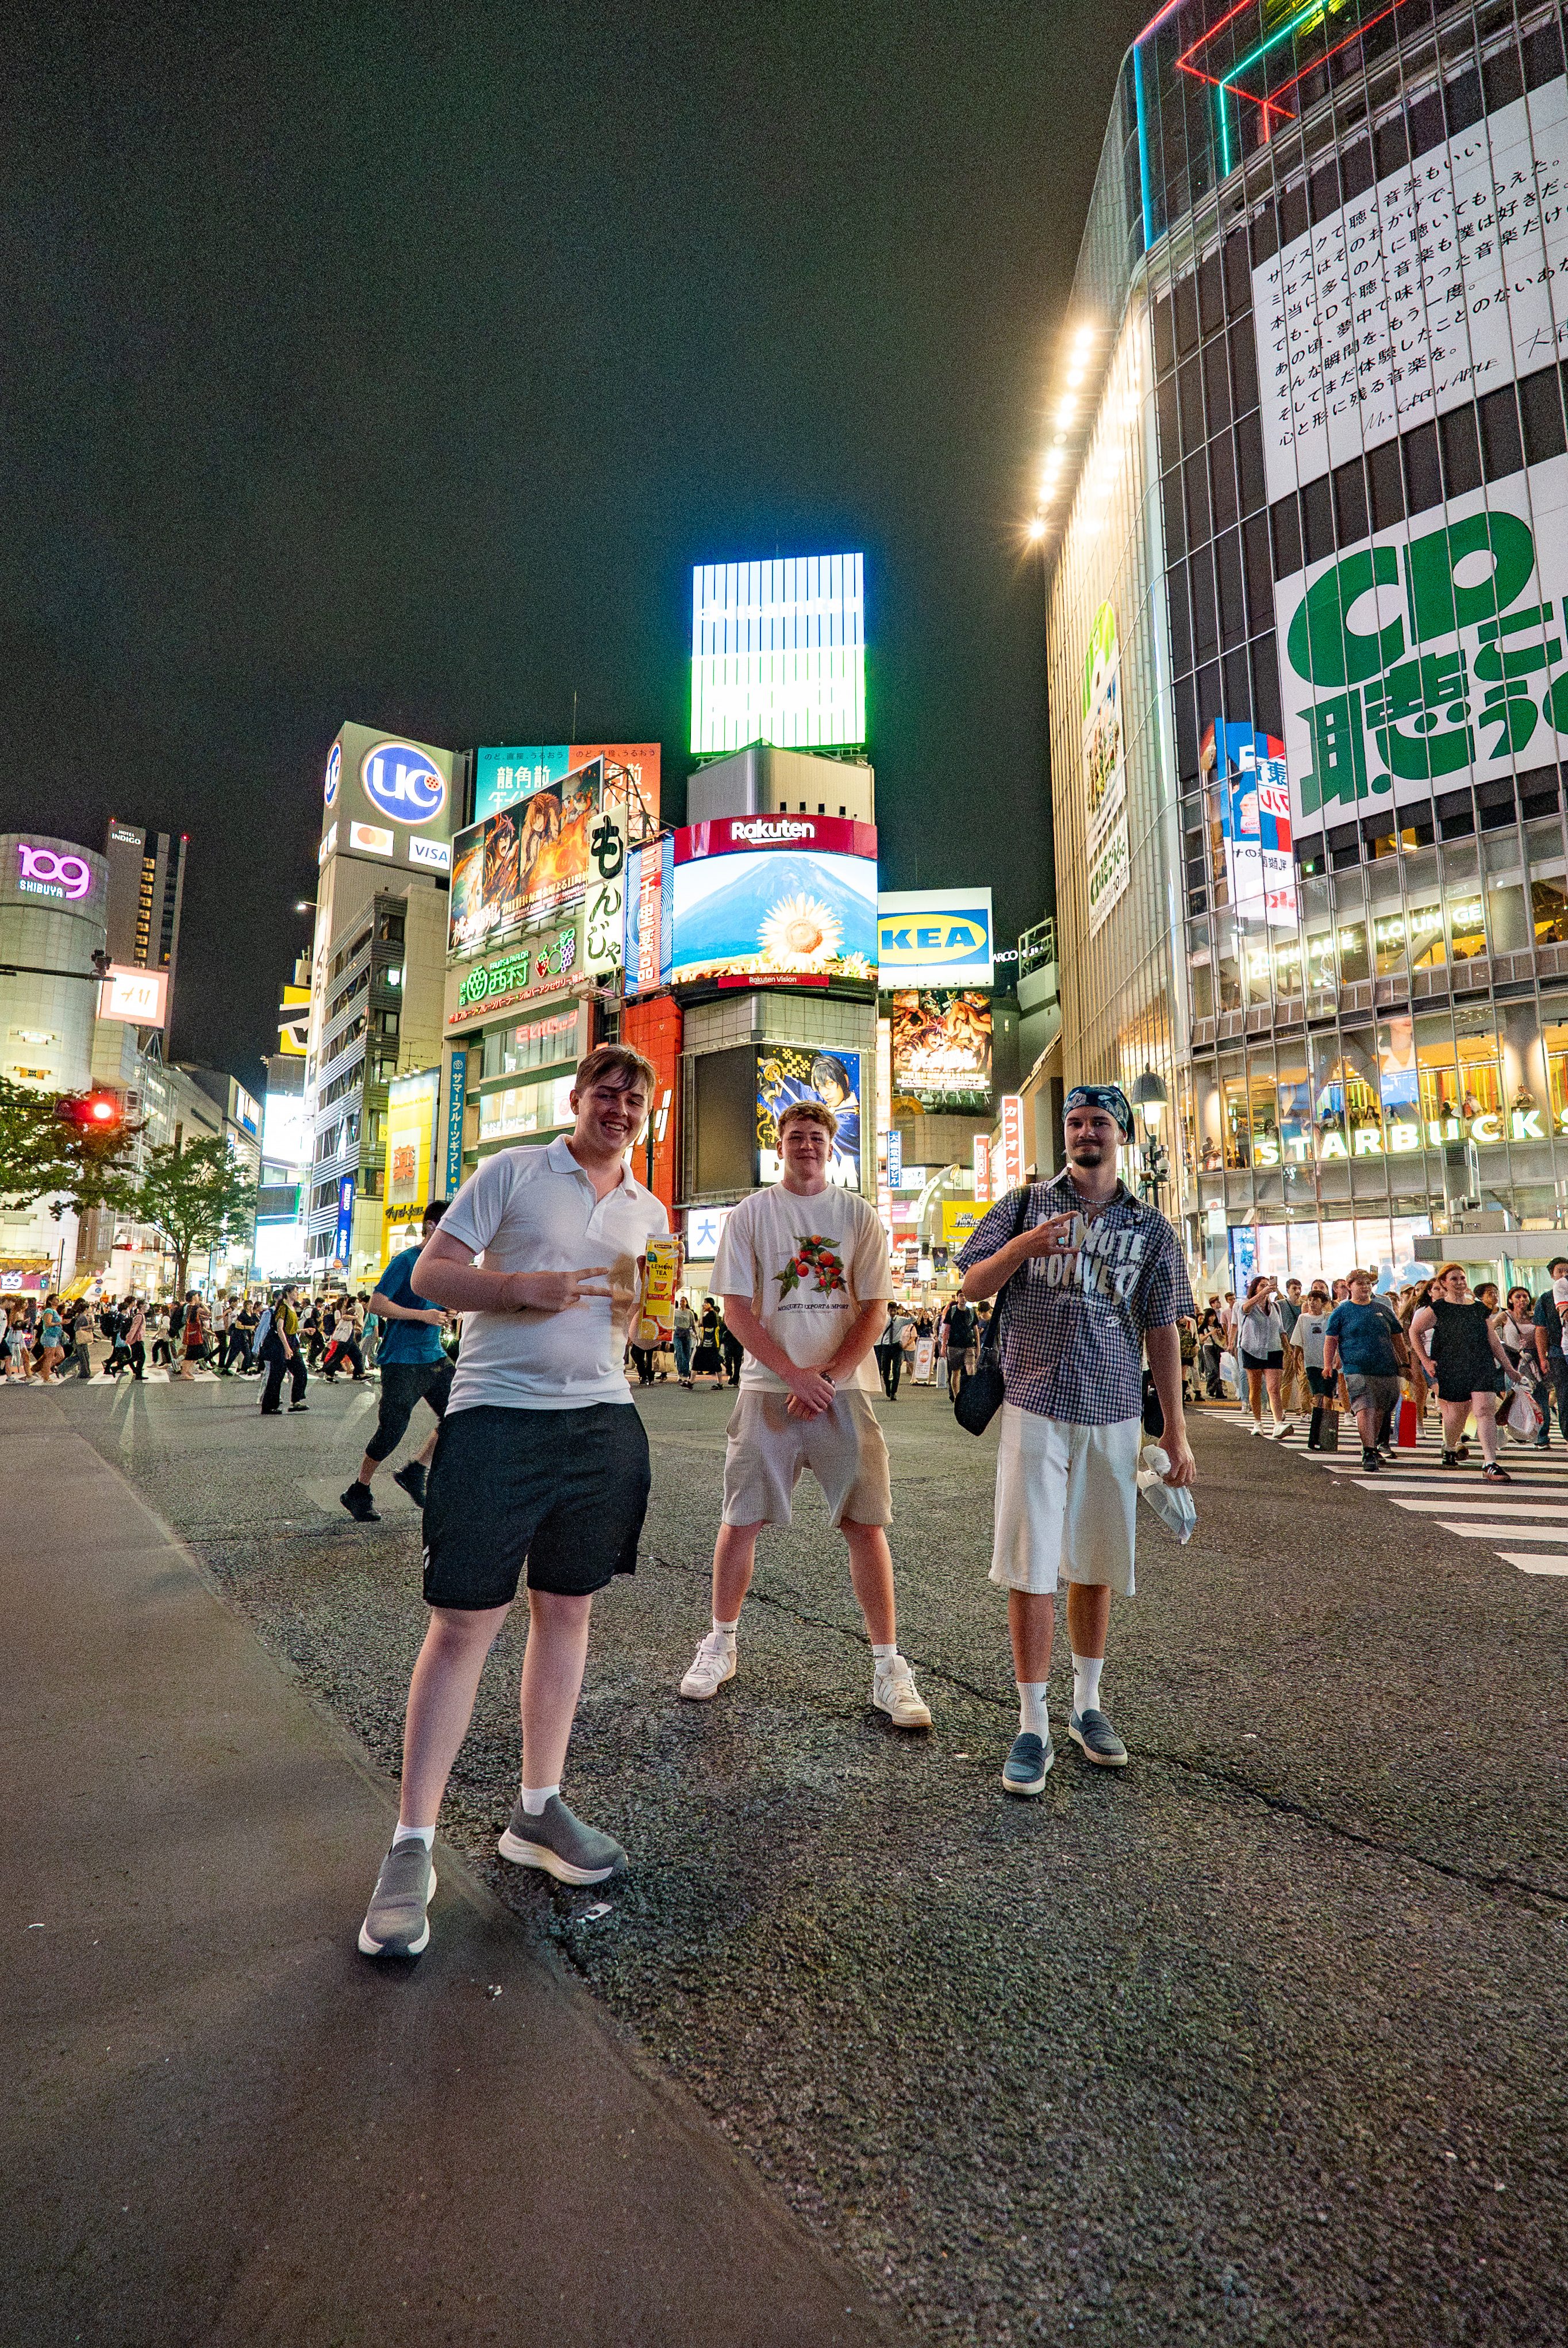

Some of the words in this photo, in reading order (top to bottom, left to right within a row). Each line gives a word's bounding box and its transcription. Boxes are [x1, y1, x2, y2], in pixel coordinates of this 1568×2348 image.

[112, 832, 141, 845] INDIGO
[118, 830, 134, 838] HOTEL
[731, 819, 815, 840] Rakuten
[415, 845, 448, 862] VISA
[18, 844, 90, 899] 109
[20, 880, 63, 898] SHIBUYA
[587, 815, 621, 965] もんじゃ
[637, 849, 662, 983] 三千里薬品
[881, 926, 977, 950] KEA
[993, 950, 1019, 963] ARCO
[488, 960, 528, 996] 西村
[450, 1073, 463, 1174] サマーフルーツギフト
[1005, 1104, 1020, 1169] カラオケ
[393, 1144, 415, 1181] 薬
[343, 1183, 352, 1211] MIZUHO
